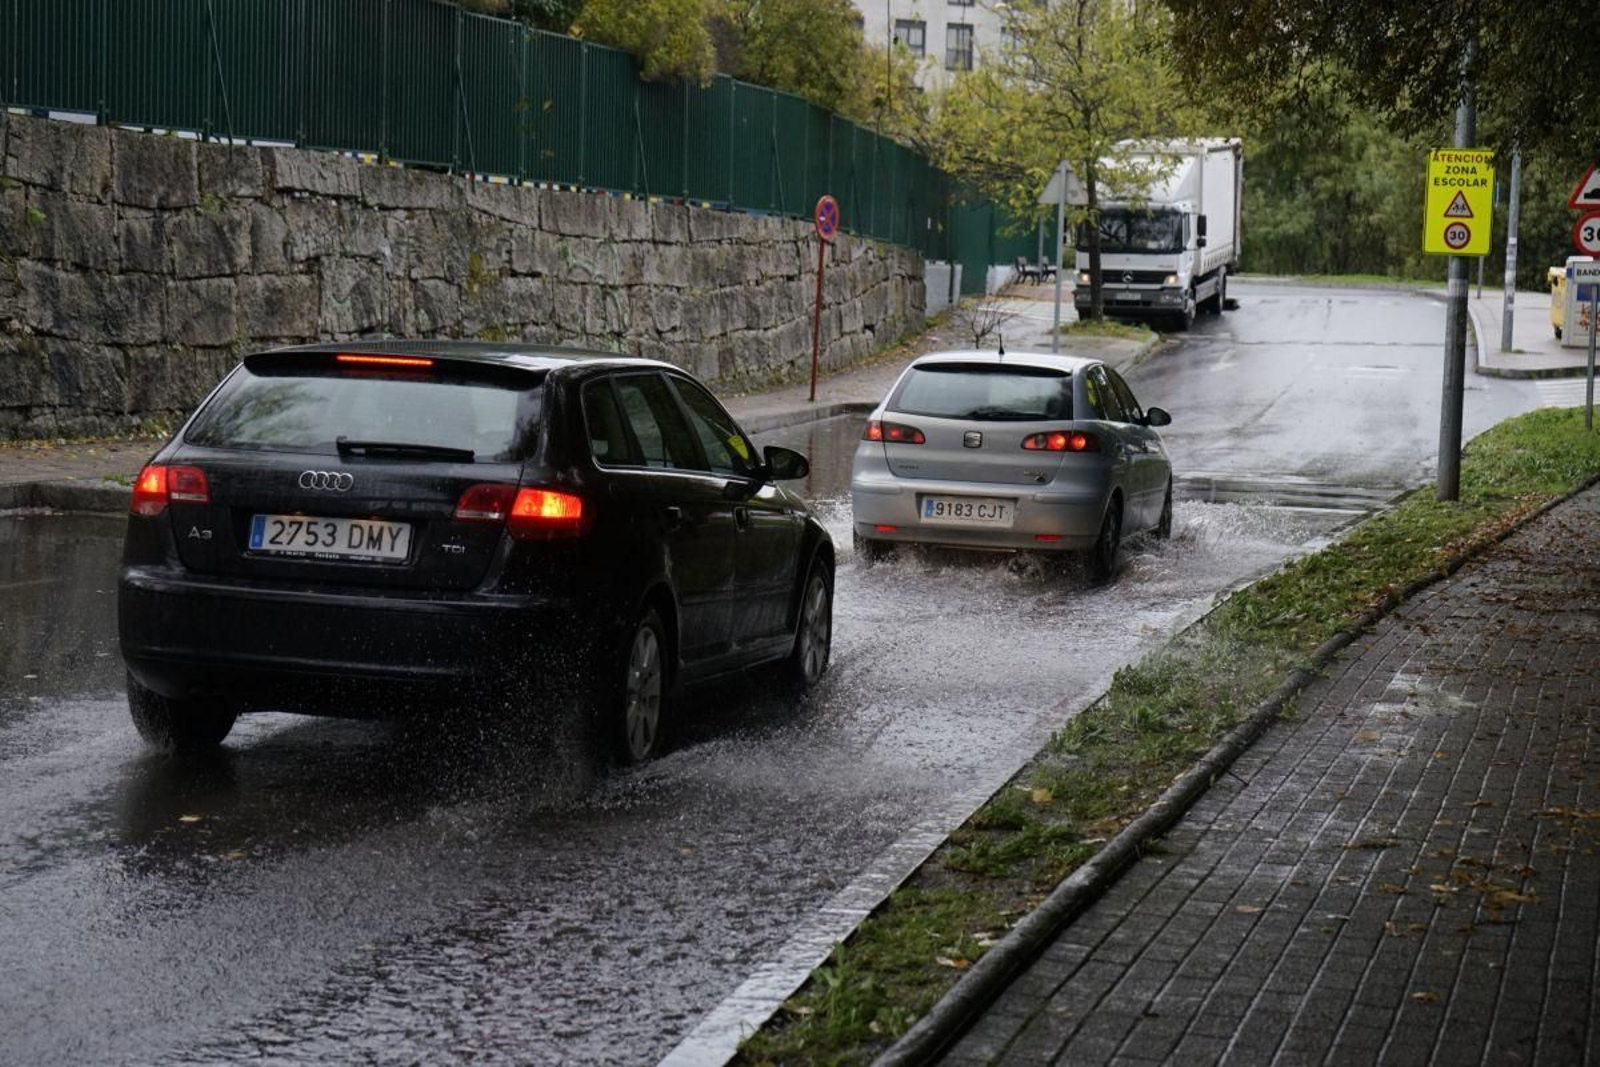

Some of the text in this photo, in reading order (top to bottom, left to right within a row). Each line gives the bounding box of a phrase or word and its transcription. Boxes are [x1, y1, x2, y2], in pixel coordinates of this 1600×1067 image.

[1445, 165, 1477, 175] ZONA
[1433, 177, 1488, 187] ESCOLAR
[1449, 230, 1465, 241] 30
[935, 502, 1006, 519] 9183 CJT
[187, 526, 213, 540] A3
[268, 520, 403, 552] 2753 DMY
